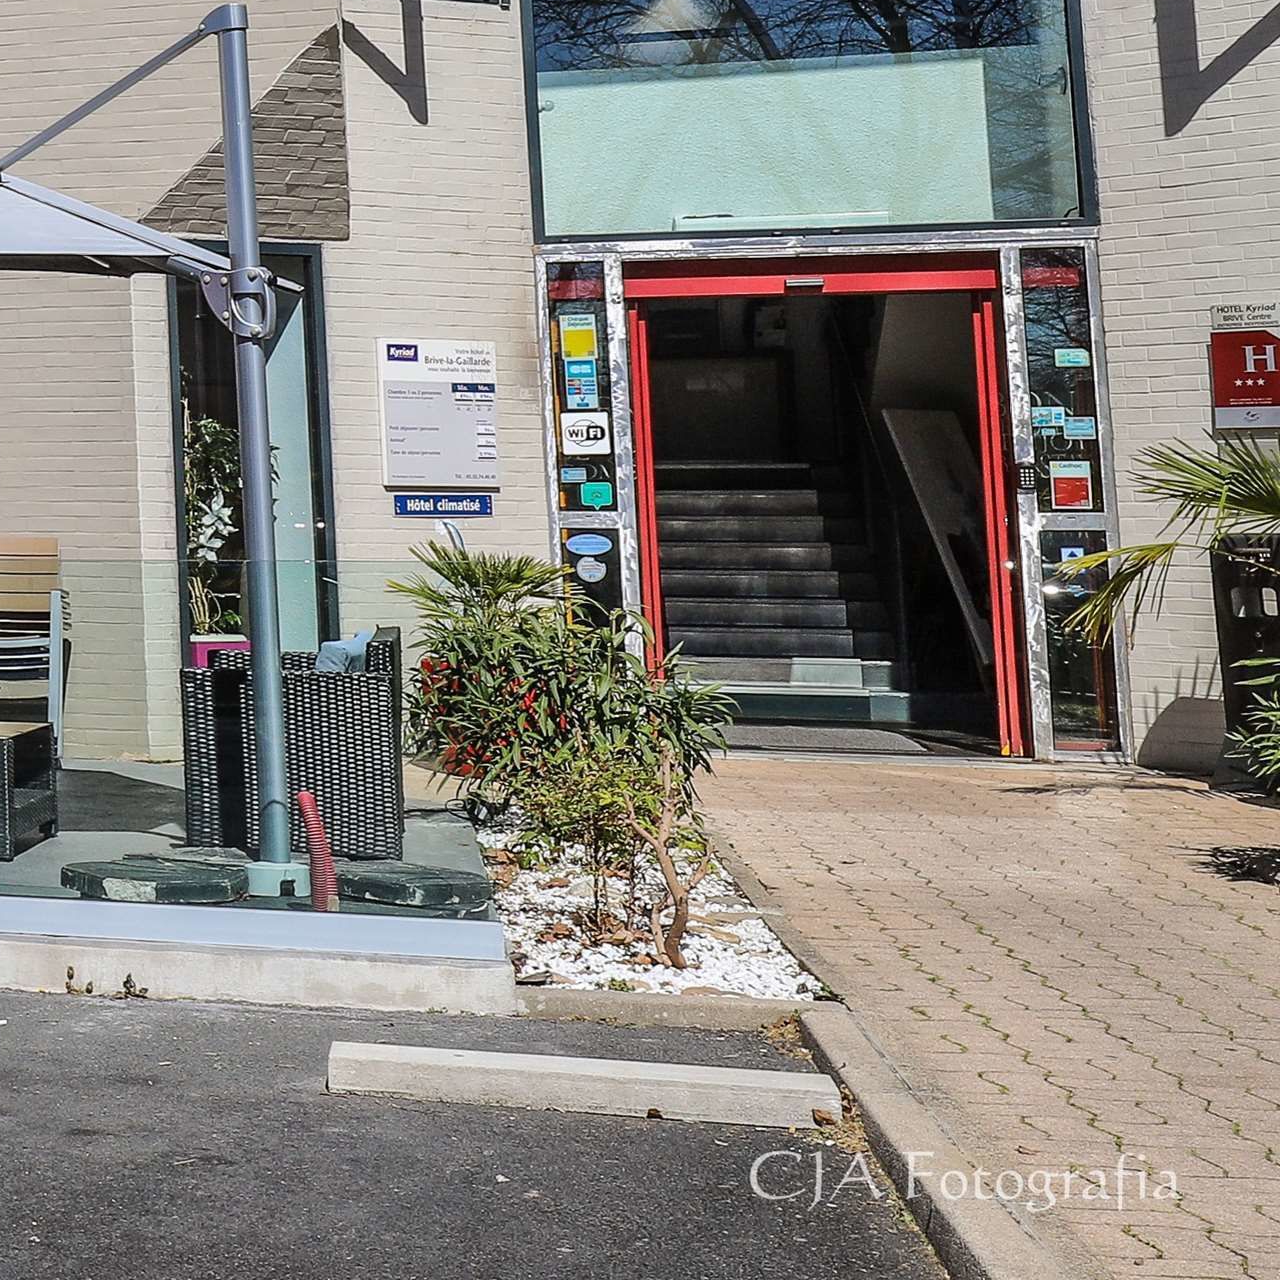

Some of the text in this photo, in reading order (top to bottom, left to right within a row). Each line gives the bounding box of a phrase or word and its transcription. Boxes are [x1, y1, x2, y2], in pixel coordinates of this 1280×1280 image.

[1217, 303, 1276, 313] HOTEL Kyriad
[1246, 313, 1272, 321] Centre
[389, 346, 415, 358] Kyriad
[424, 355, 492, 366] Brive-la-Gaillarde
[1241, 344, 1280, 372] H
[406, 498, 481, 511] Hôtel climatisé
